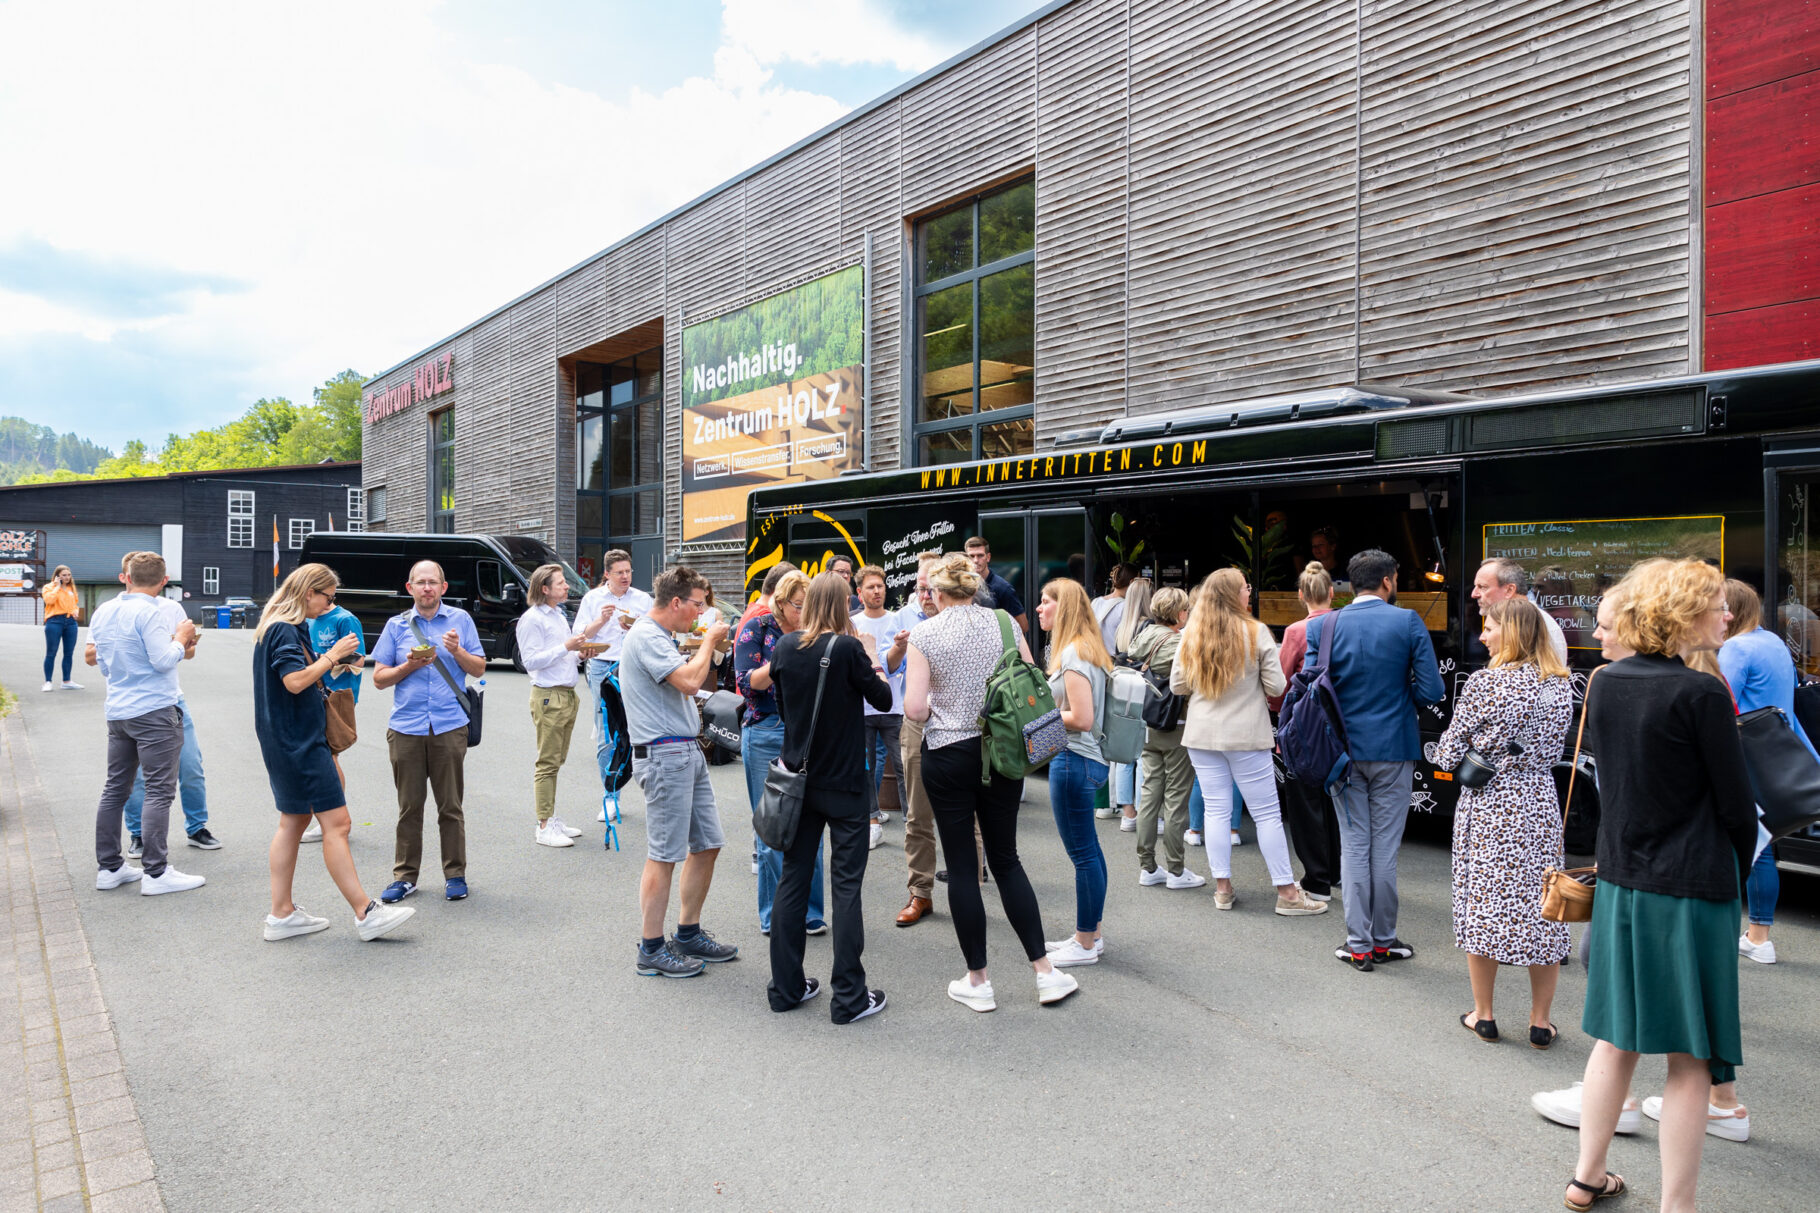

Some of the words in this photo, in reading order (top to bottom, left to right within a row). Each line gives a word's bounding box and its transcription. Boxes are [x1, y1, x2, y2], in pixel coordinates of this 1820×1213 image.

[692, 339, 803, 394] Nachhaltig.
[366, 381, 411, 424] Zentrum
[414, 352, 452, 403] HOLZ
[693, 405, 773, 446] Zentrum
[777, 382, 847, 428] HOLZ.
[696, 462, 728, 475] Netzwerk.
[734, 449, 791, 468] Wissenstransfer.
[799, 440, 844, 457] Forschung.
[921, 440, 1207, 489] WWW.INNEFRITTEN.COM
[760, 512, 779, 536] EST.
[882, 533, 910, 555] Besucht
[929, 520, 955, 540] Fritten
[883, 560, 894, 572] bei
